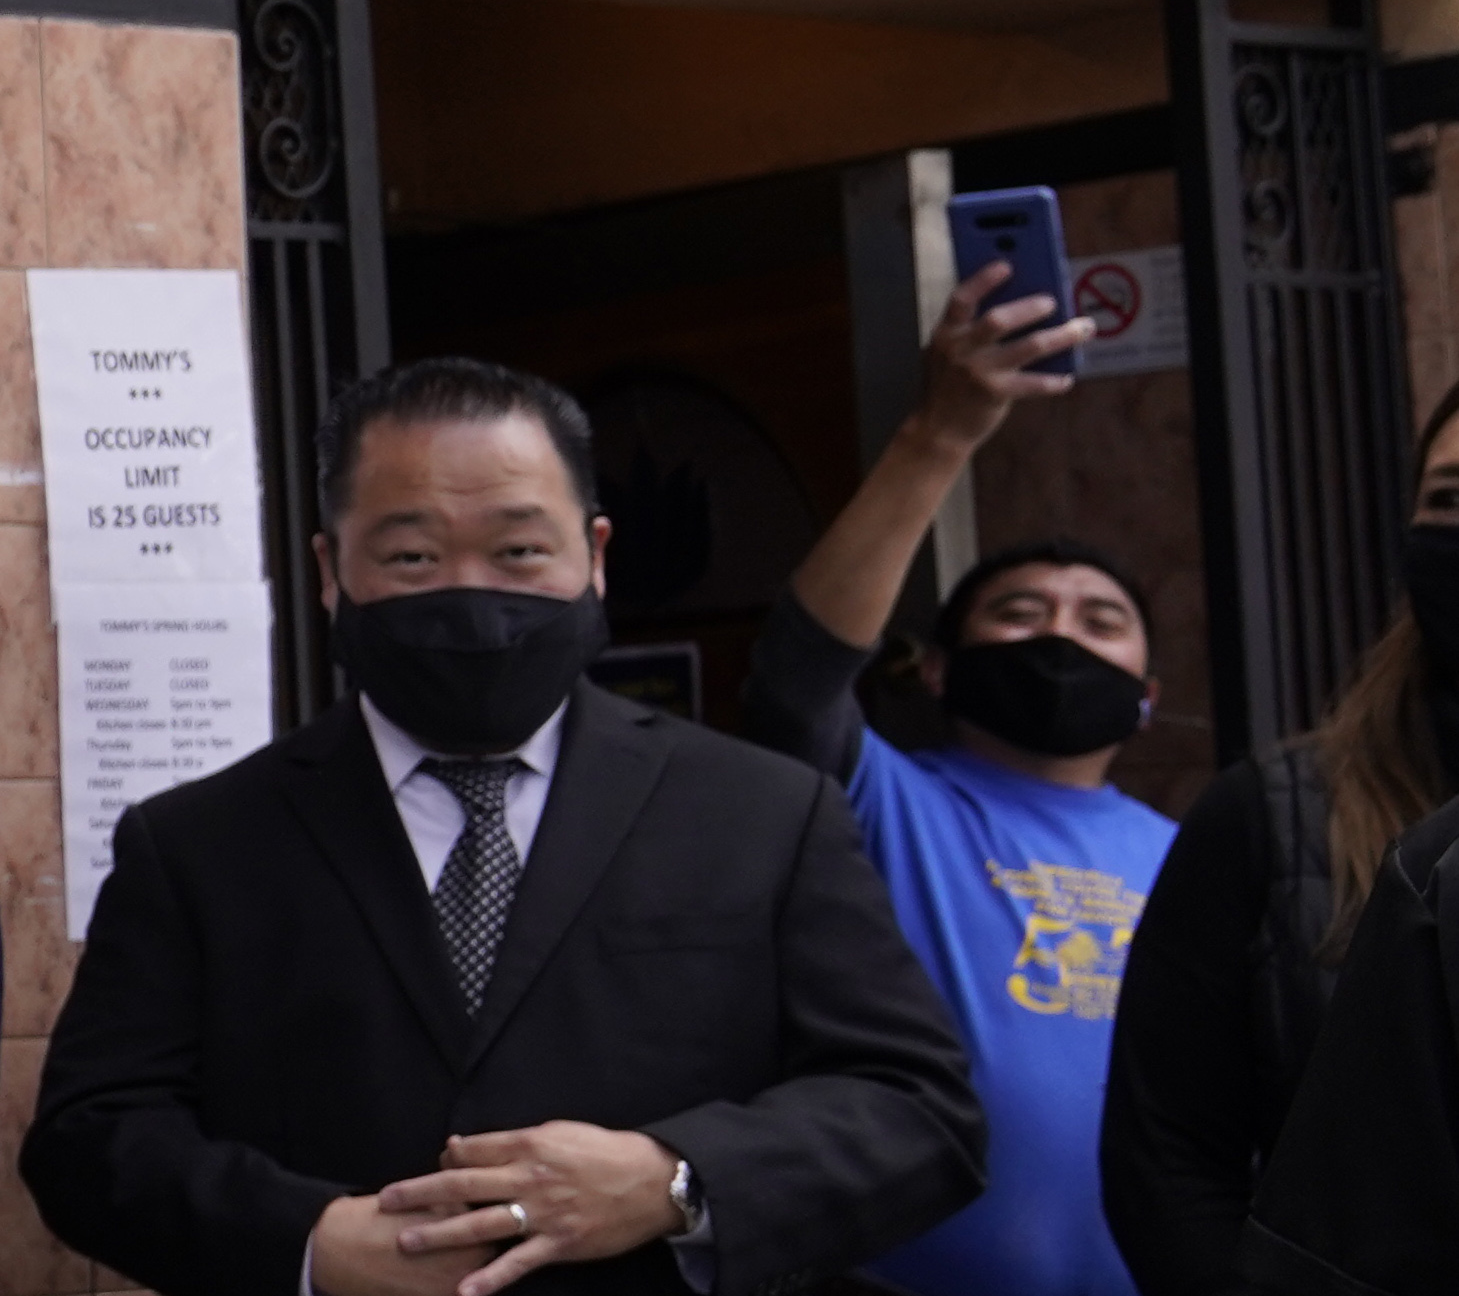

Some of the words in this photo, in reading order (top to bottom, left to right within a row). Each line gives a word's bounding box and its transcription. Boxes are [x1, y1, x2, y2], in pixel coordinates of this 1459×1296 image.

[90, 351, 192, 372] TOMMY'S
[84, 427, 212, 450] OCCUPANCY
[124, 465, 180, 488] LIMIT
[88, 506, 106, 528] IS
[113, 505, 136, 528] 25
[143, 503, 221, 527] GUESTS
